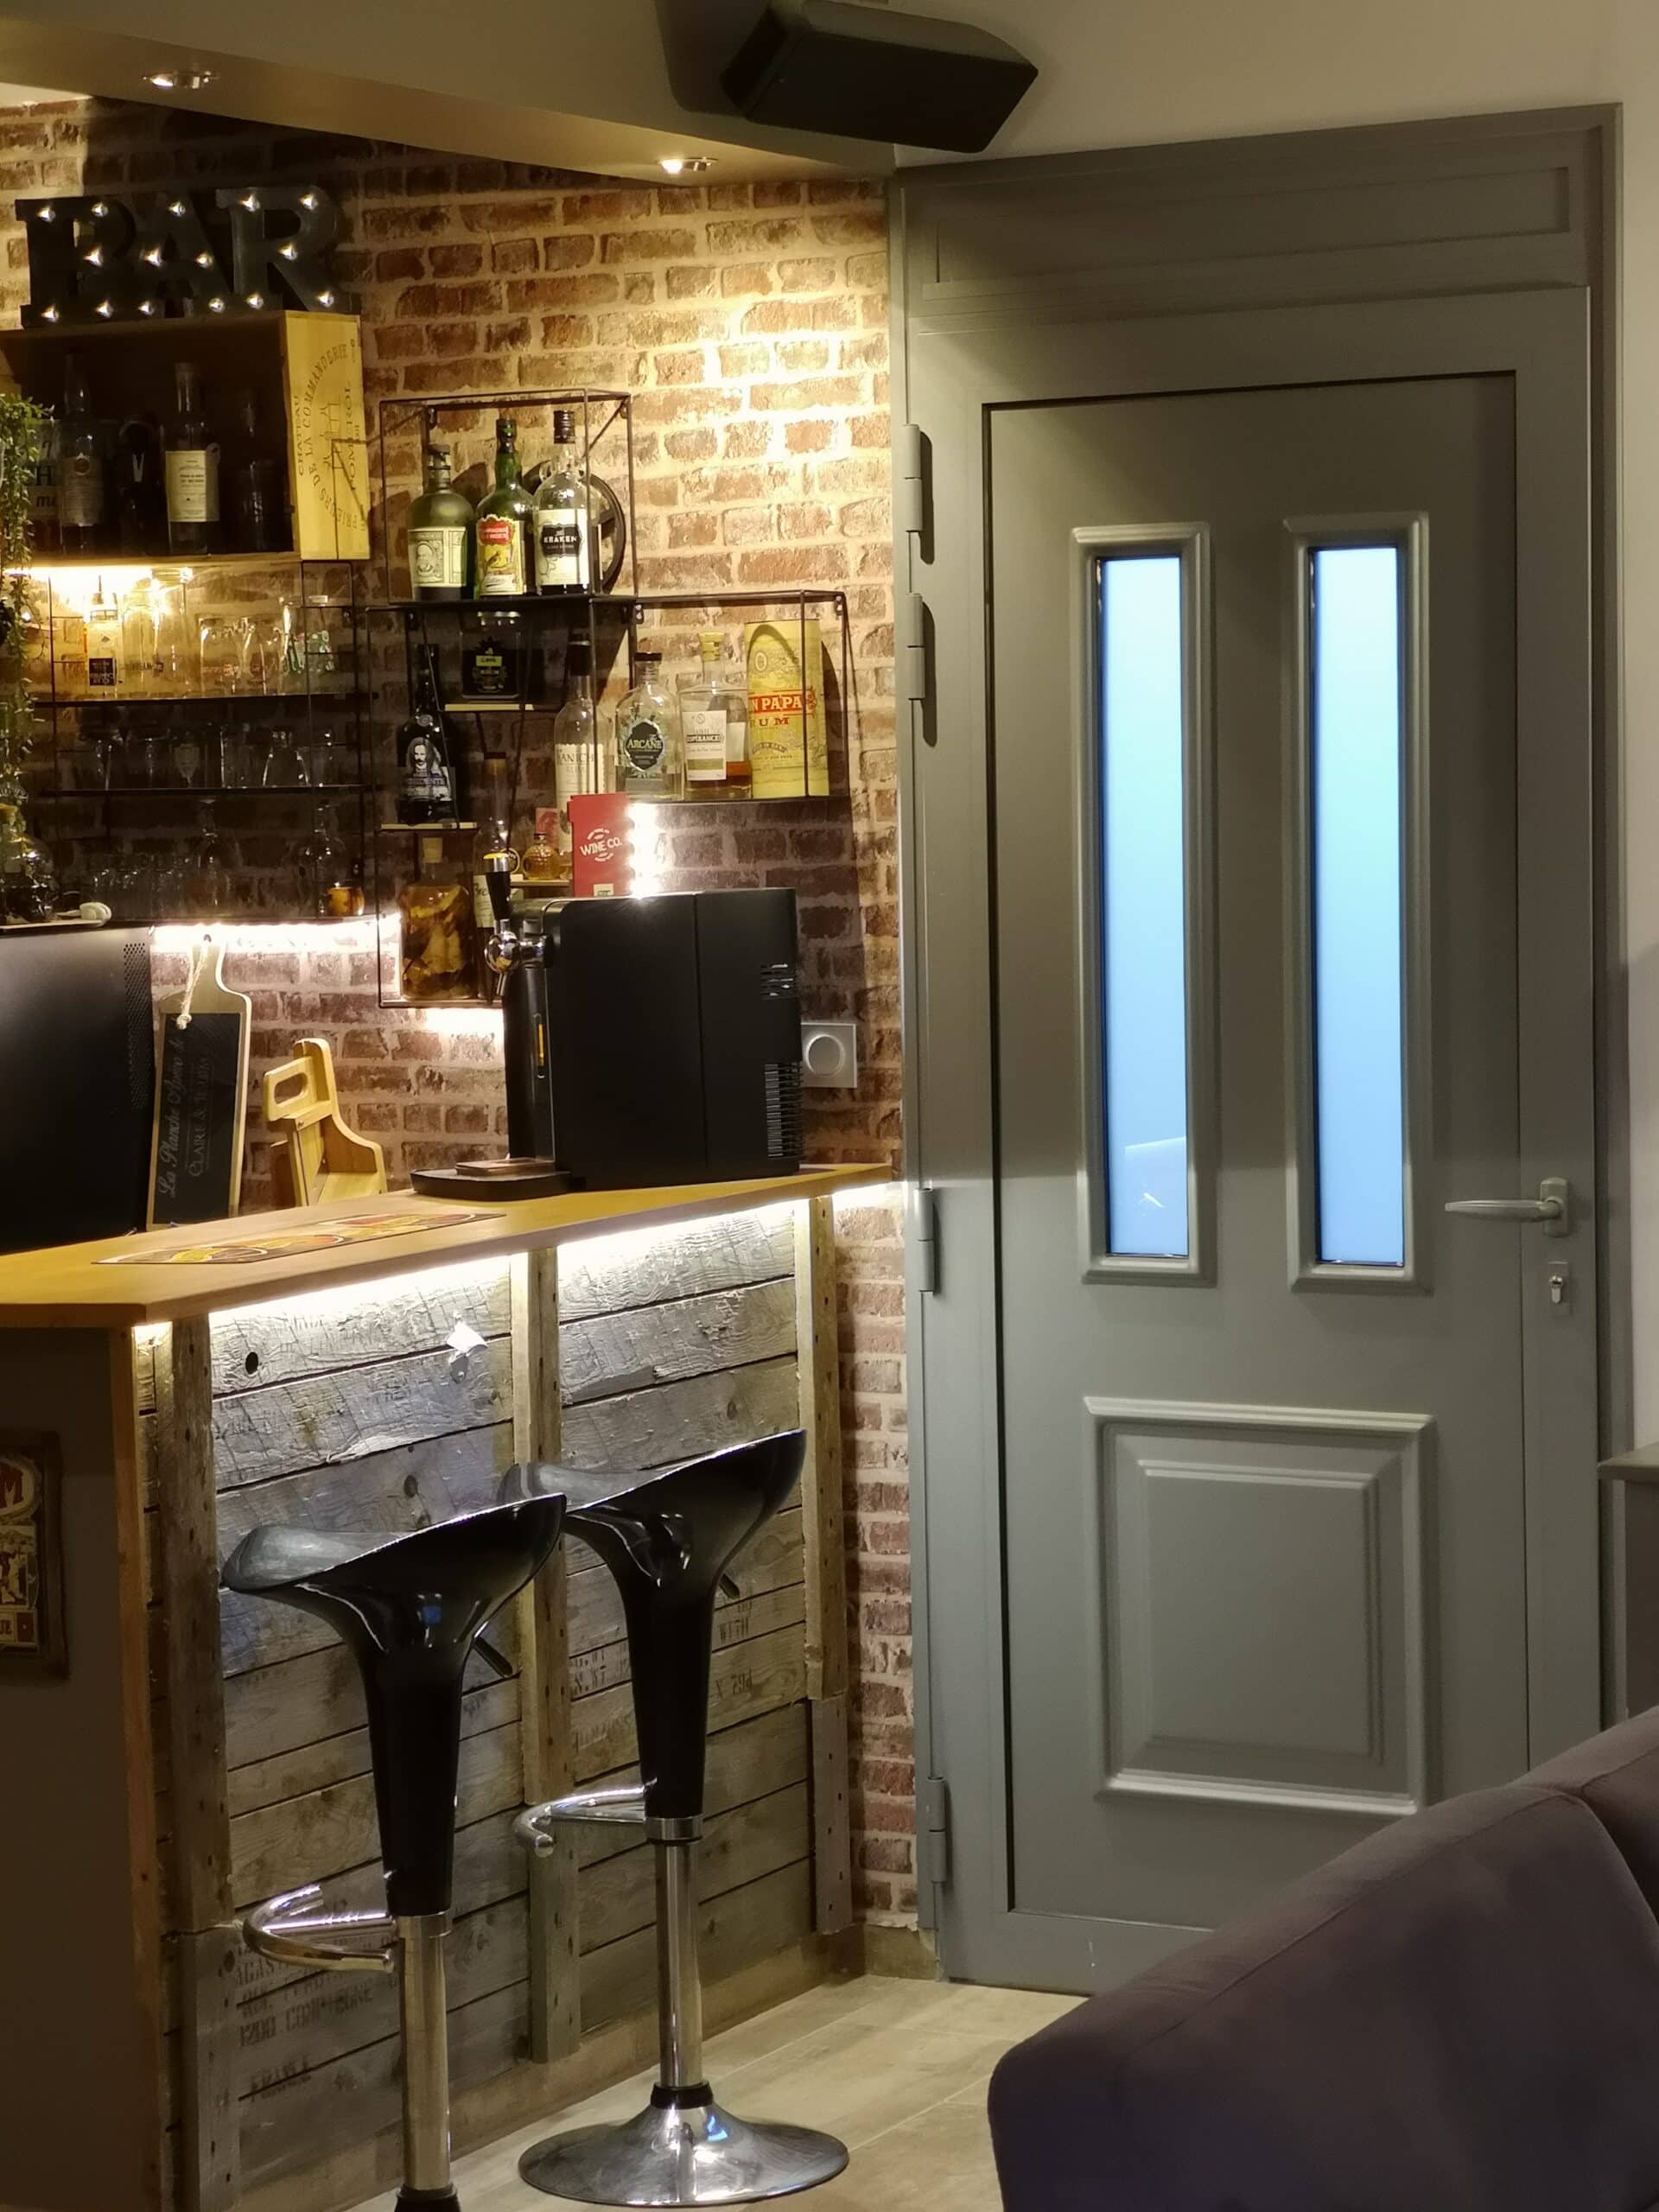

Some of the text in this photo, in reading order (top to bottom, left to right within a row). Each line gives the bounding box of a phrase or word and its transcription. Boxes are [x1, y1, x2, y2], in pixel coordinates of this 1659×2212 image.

[16, 185, 359, 327] BAR
[292, 394, 304, 476] CHATEAU
[303, 435, 314, 457] LA
[308, 462, 321, 487] DE
[761, 695, 804, 711] PAPA
[627, 737, 663, 749] ARCANE
[580, 842, 607, 856] WINE
